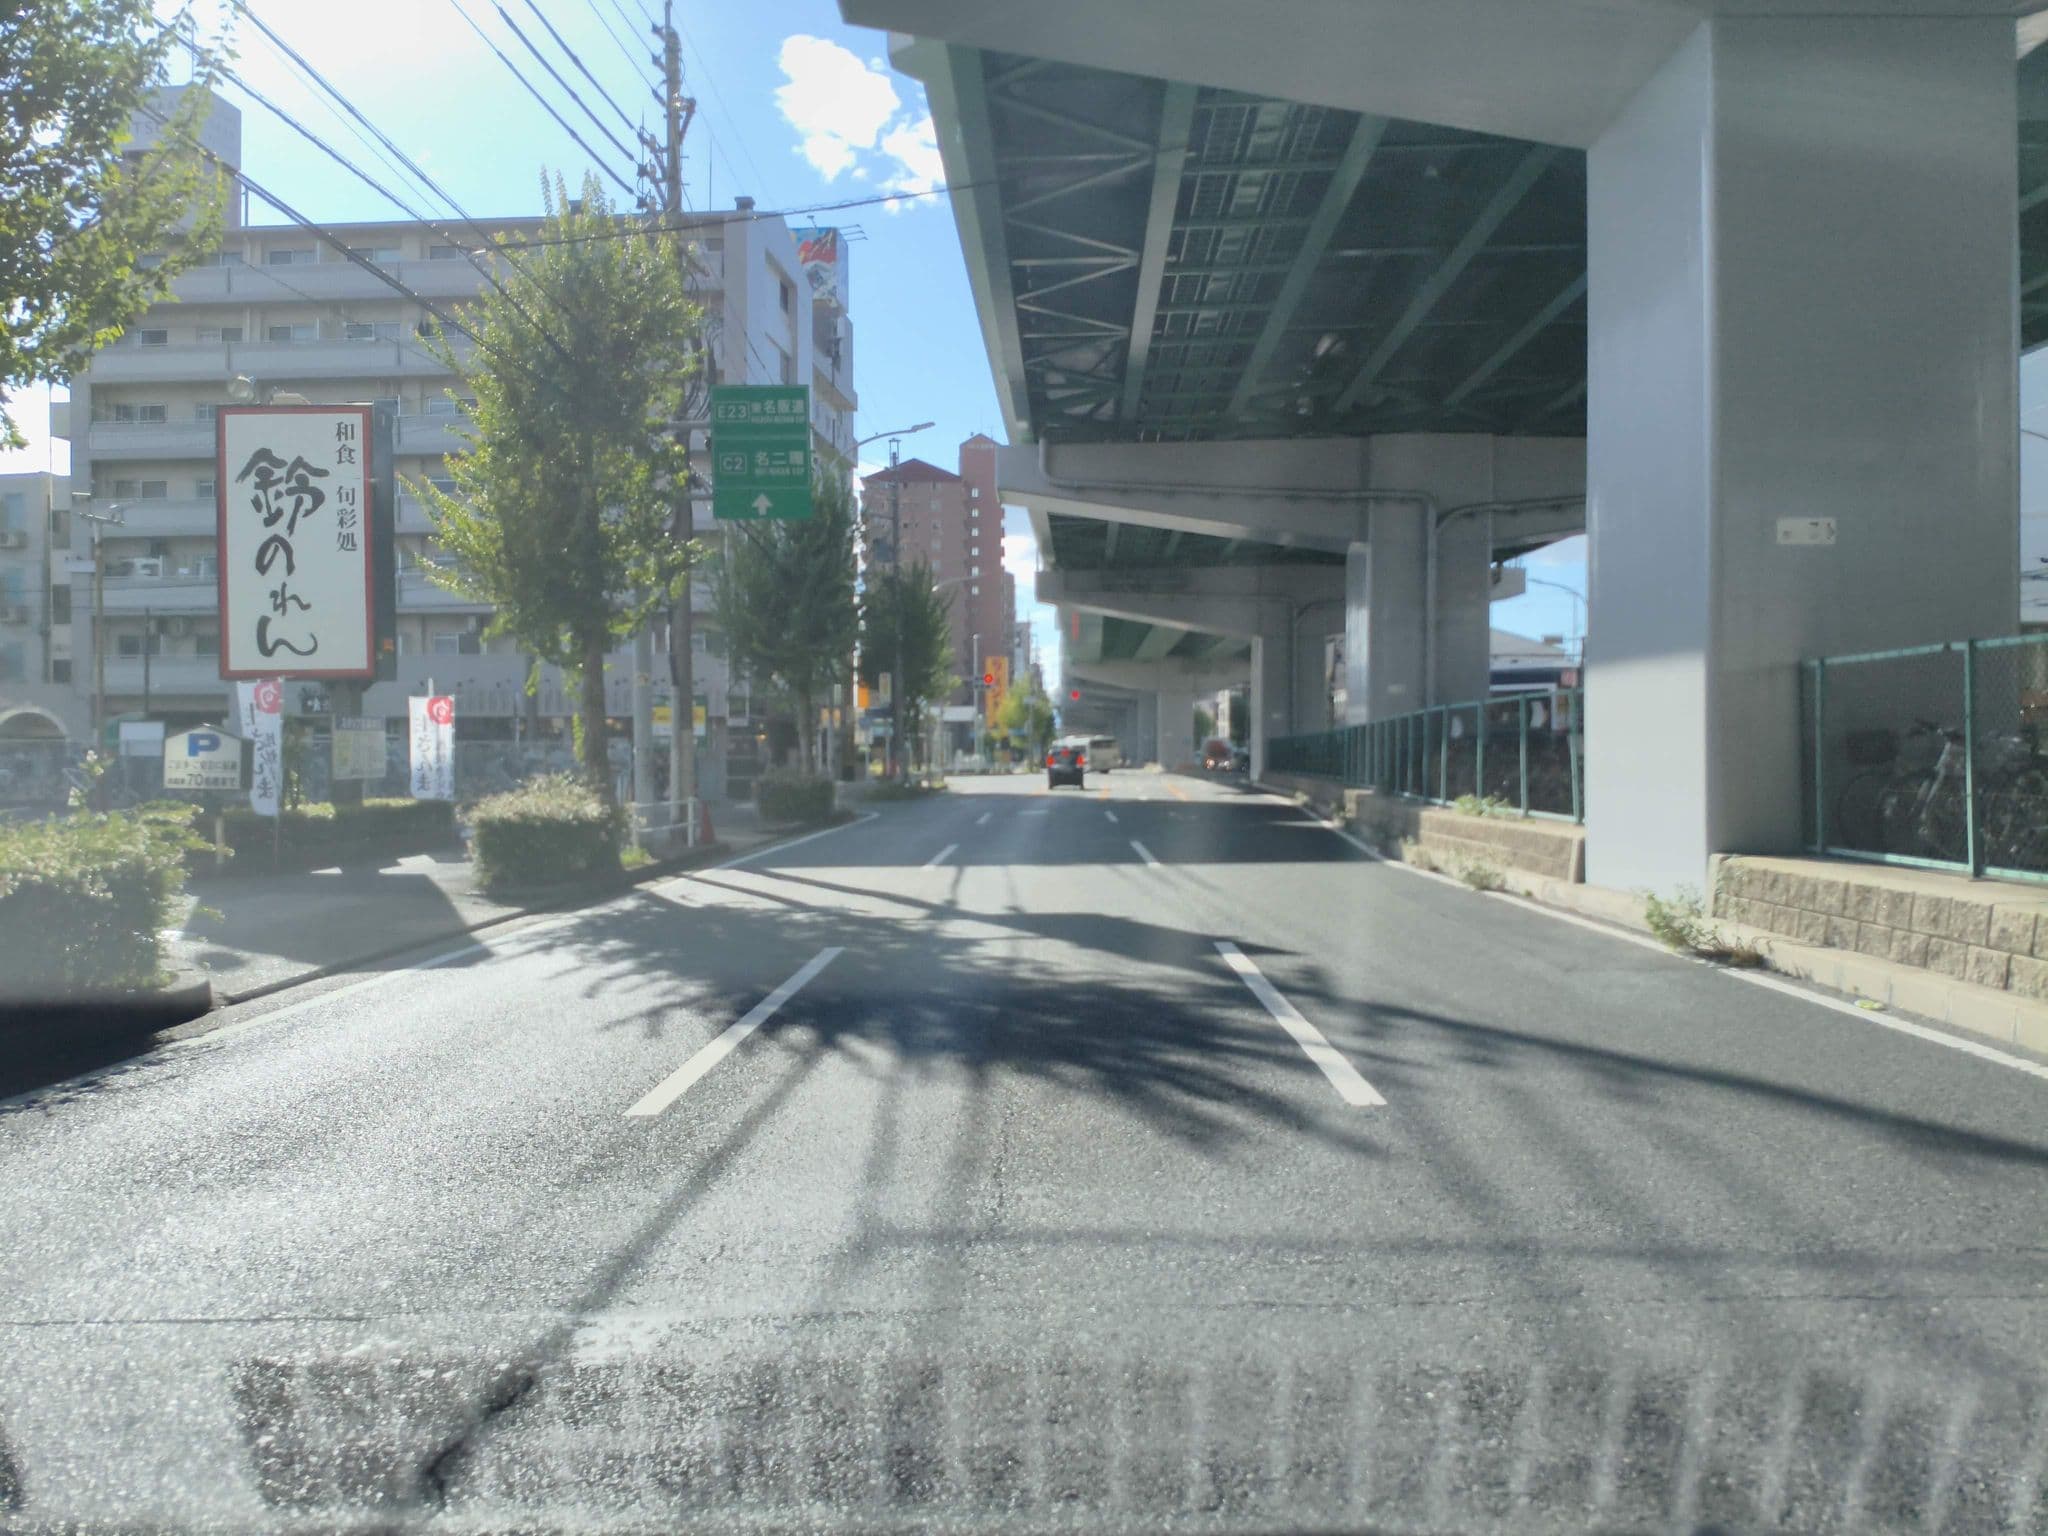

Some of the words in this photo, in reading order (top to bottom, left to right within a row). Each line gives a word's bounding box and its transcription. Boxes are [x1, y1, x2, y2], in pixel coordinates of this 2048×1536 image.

[717, 405, 747, 418] E23
[335, 421, 356, 465] 和食
[722, 456, 744, 471] C2
[336, 486, 357, 552] 旬彩処
[235, 448, 330, 657] 鈴のれん
[188, 733, 221, 757] P
